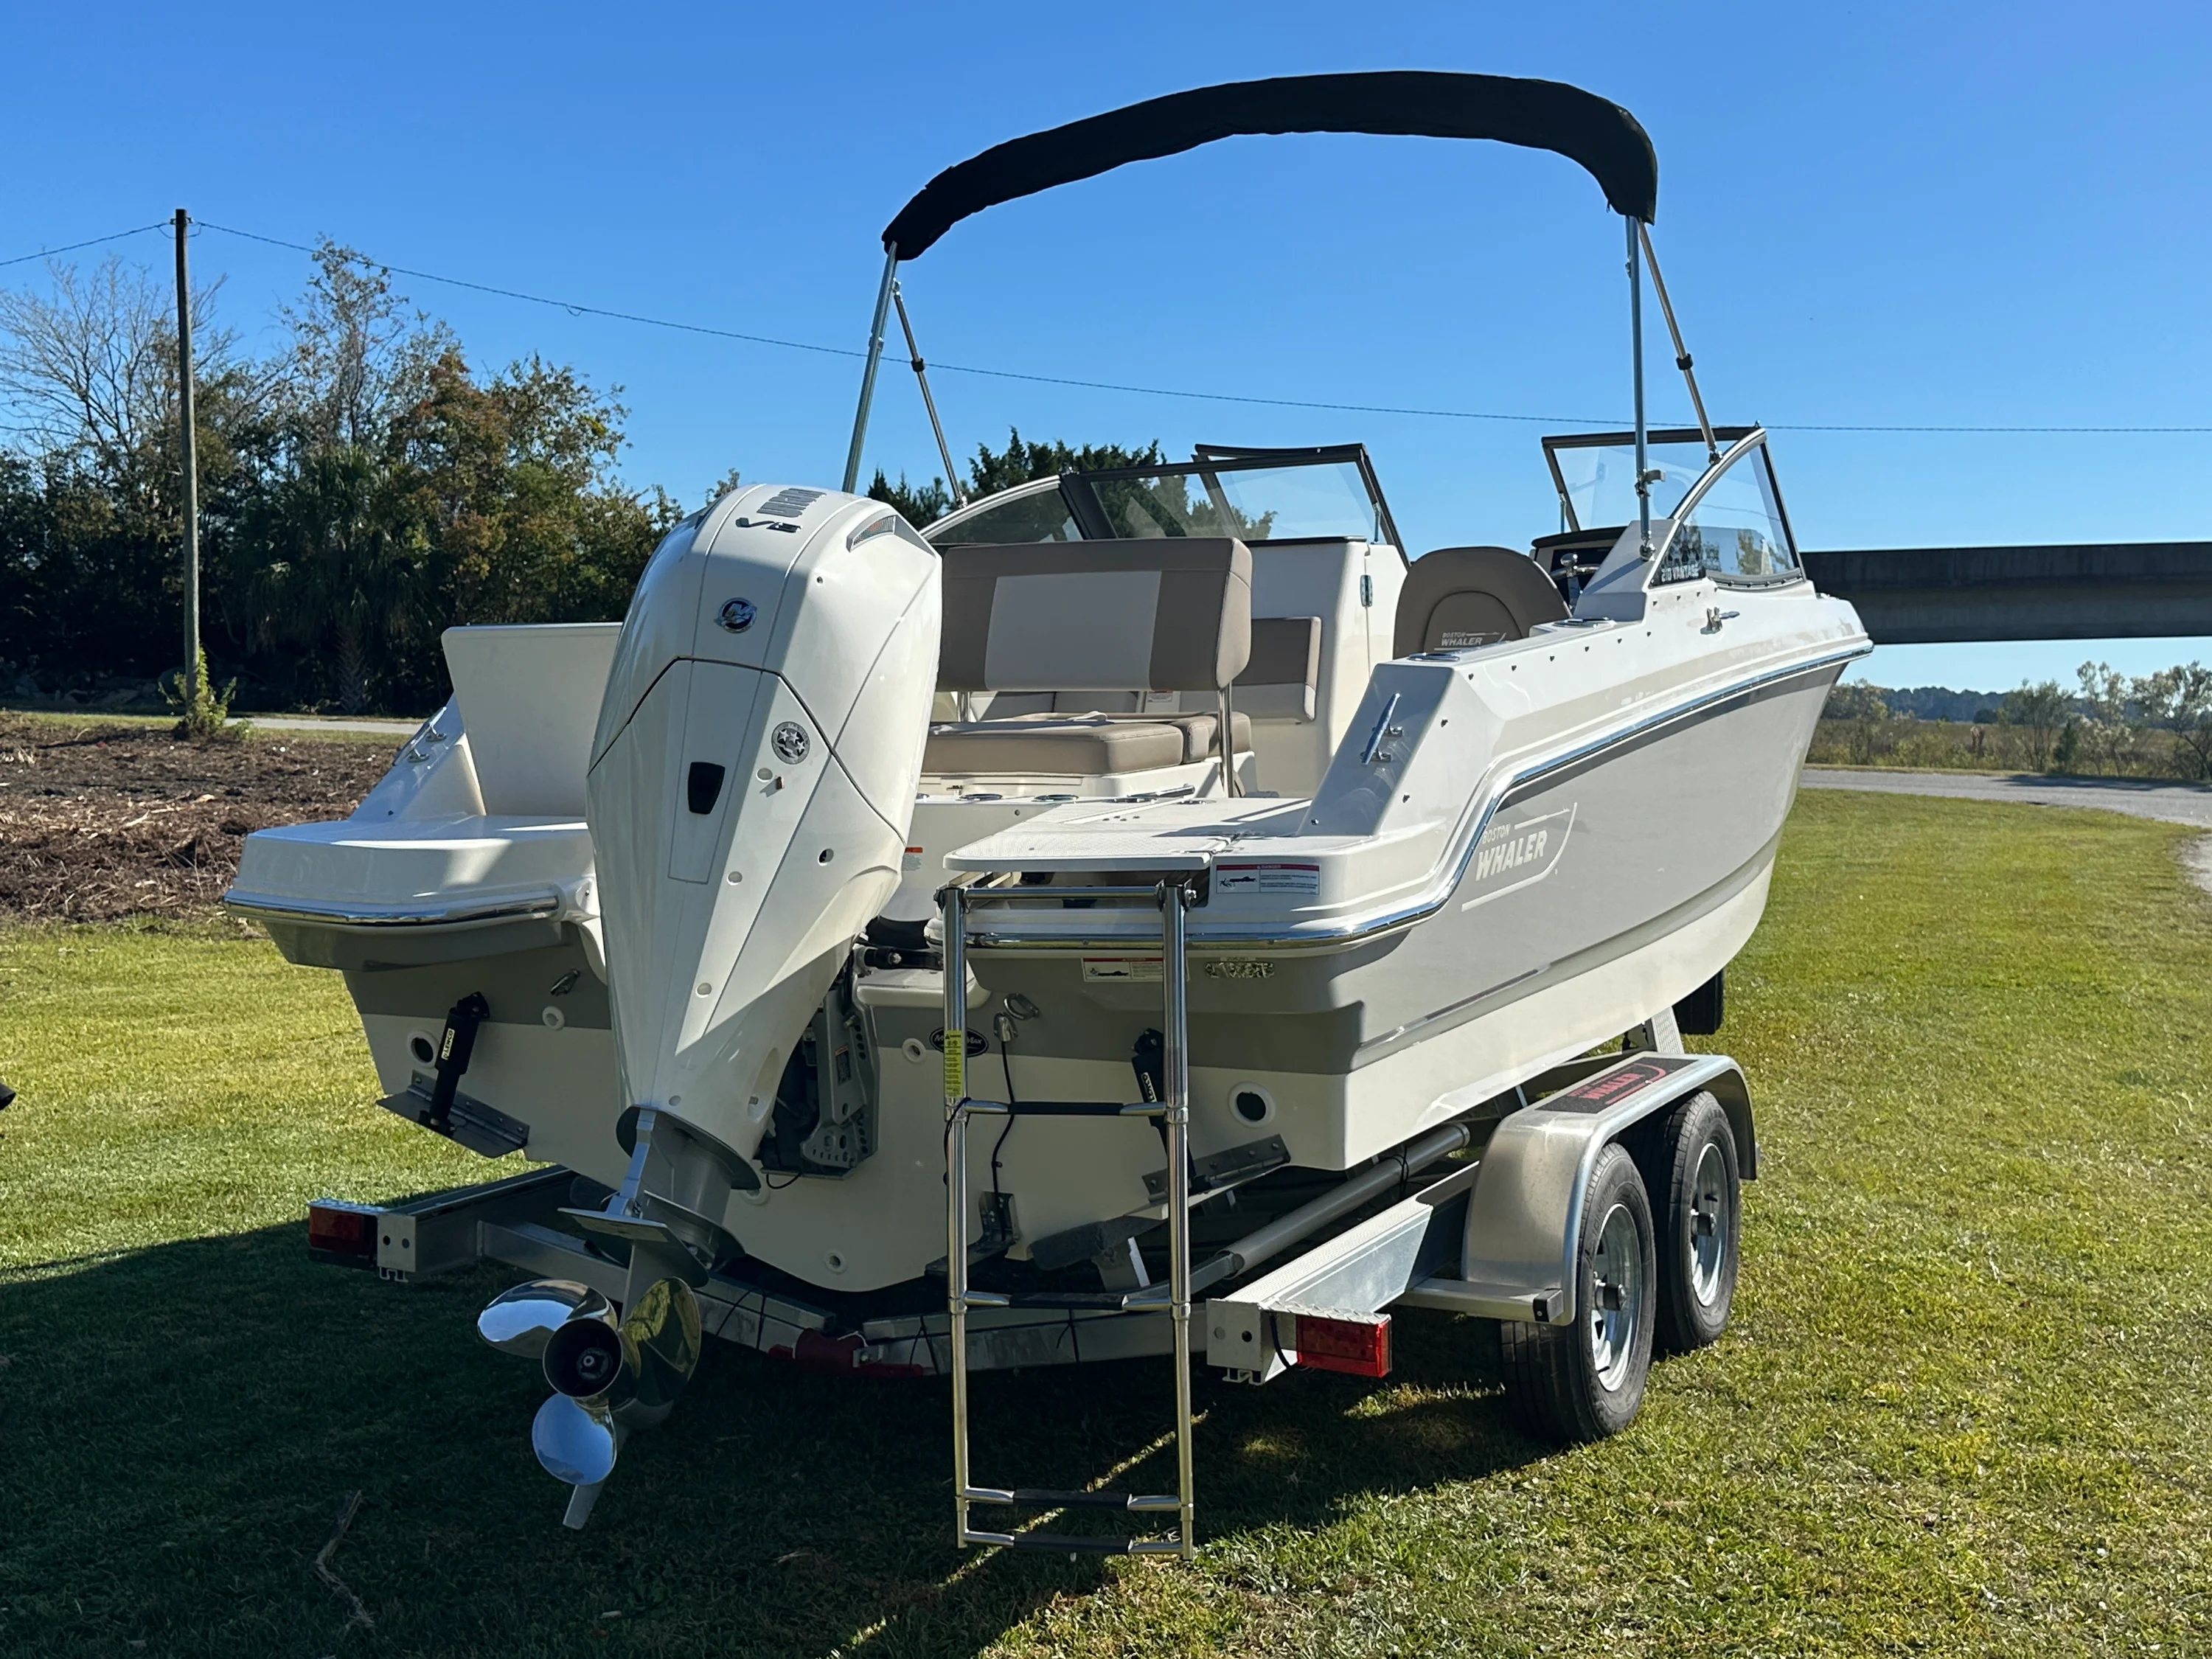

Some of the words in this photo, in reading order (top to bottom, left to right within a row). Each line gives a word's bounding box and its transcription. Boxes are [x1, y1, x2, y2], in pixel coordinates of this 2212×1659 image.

[1441, 637, 1483, 647] WHALER
[1482, 823, 1511, 844] BOSTON
[1475, 830, 1548, 881] WHALER
